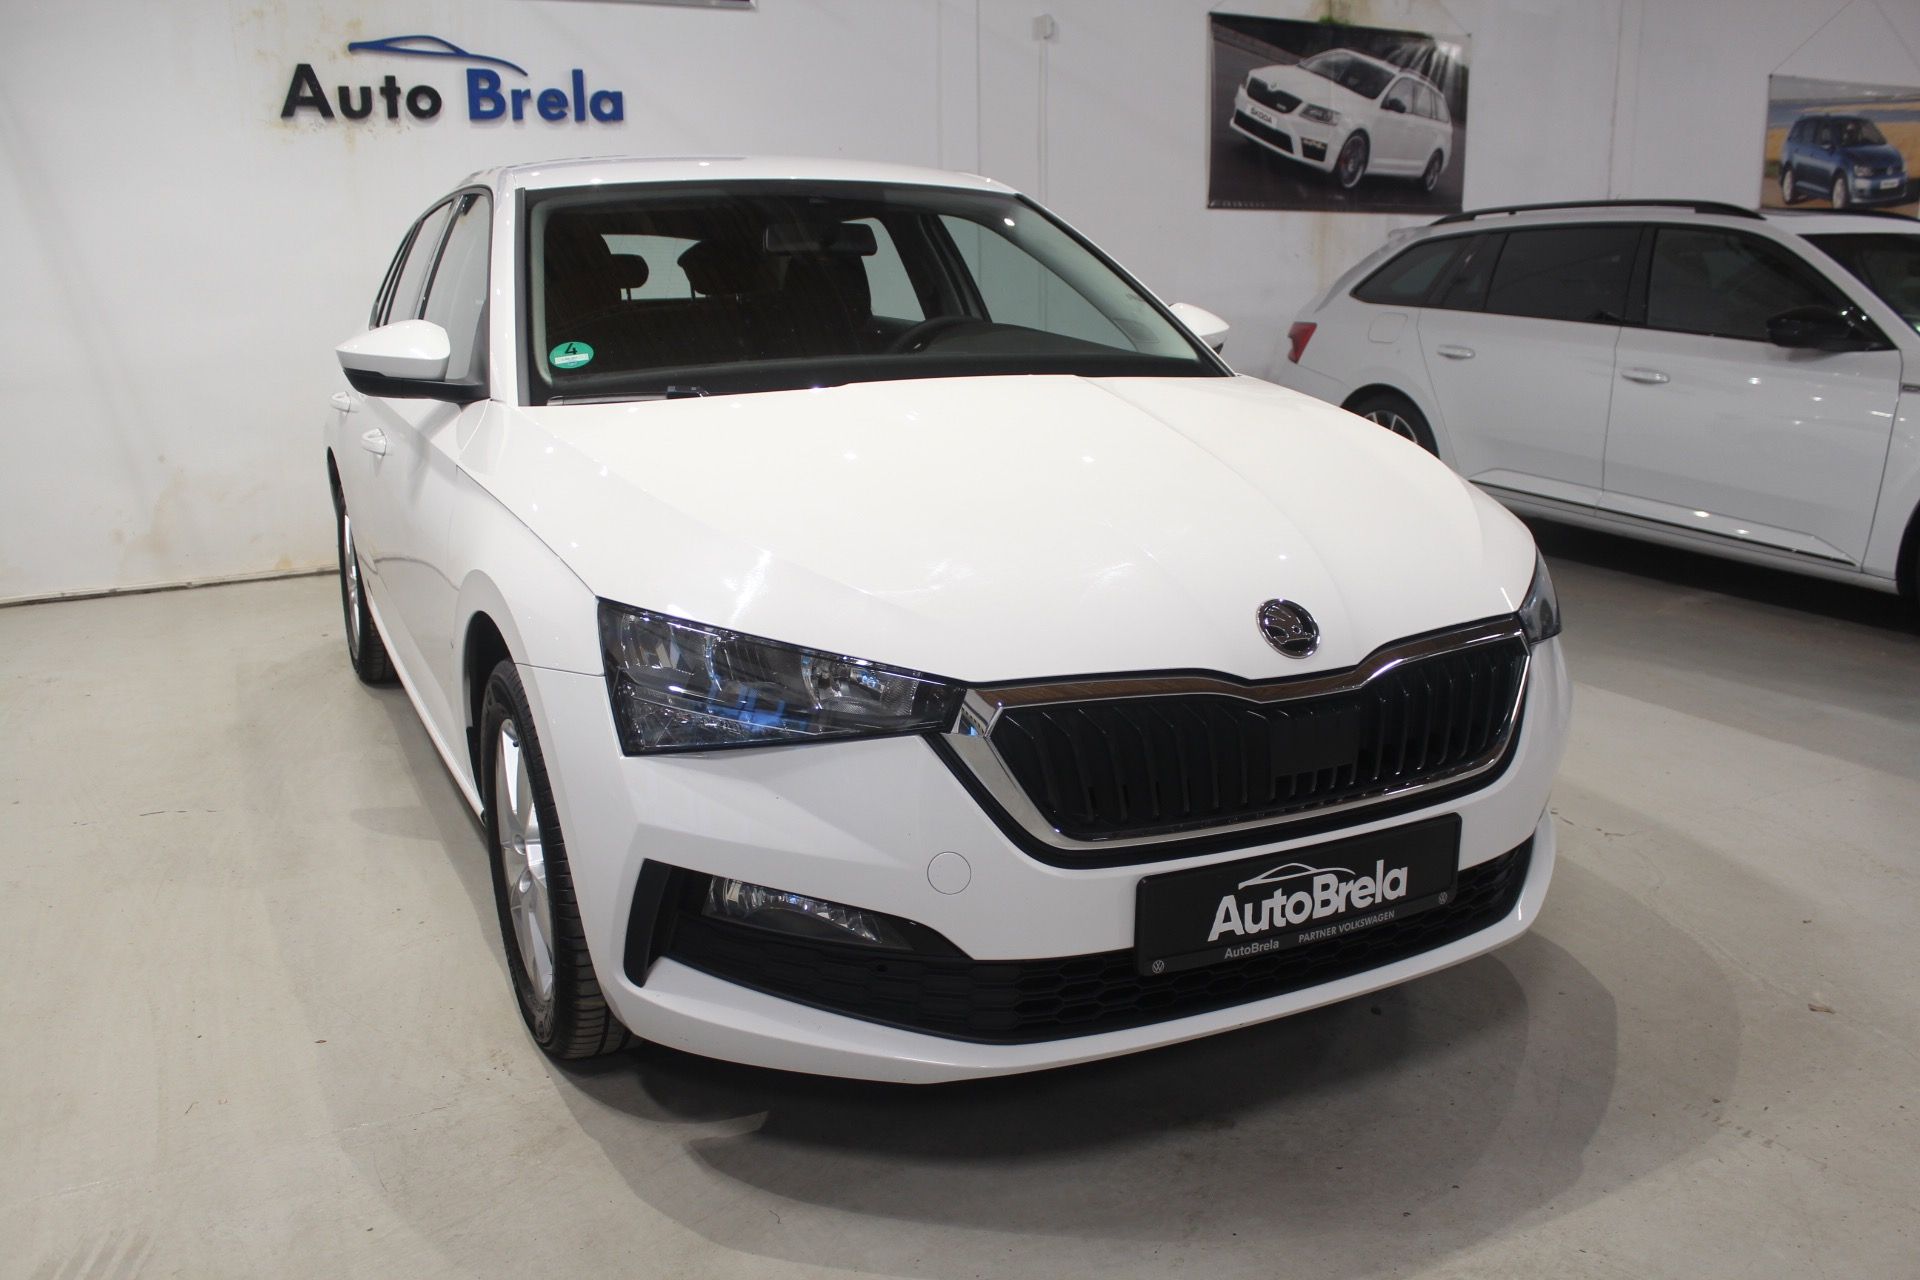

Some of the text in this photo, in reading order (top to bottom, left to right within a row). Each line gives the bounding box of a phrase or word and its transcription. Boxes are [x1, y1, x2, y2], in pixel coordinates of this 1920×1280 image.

[281, 63, 625, 122] Auto Brela
[564, 342, 577, 354] 4
[1207, 859, 1409, 942] AutoBrela
[1224, 910, 1395, 959] AutoBrela PARTNER VOLKSWAGEN
